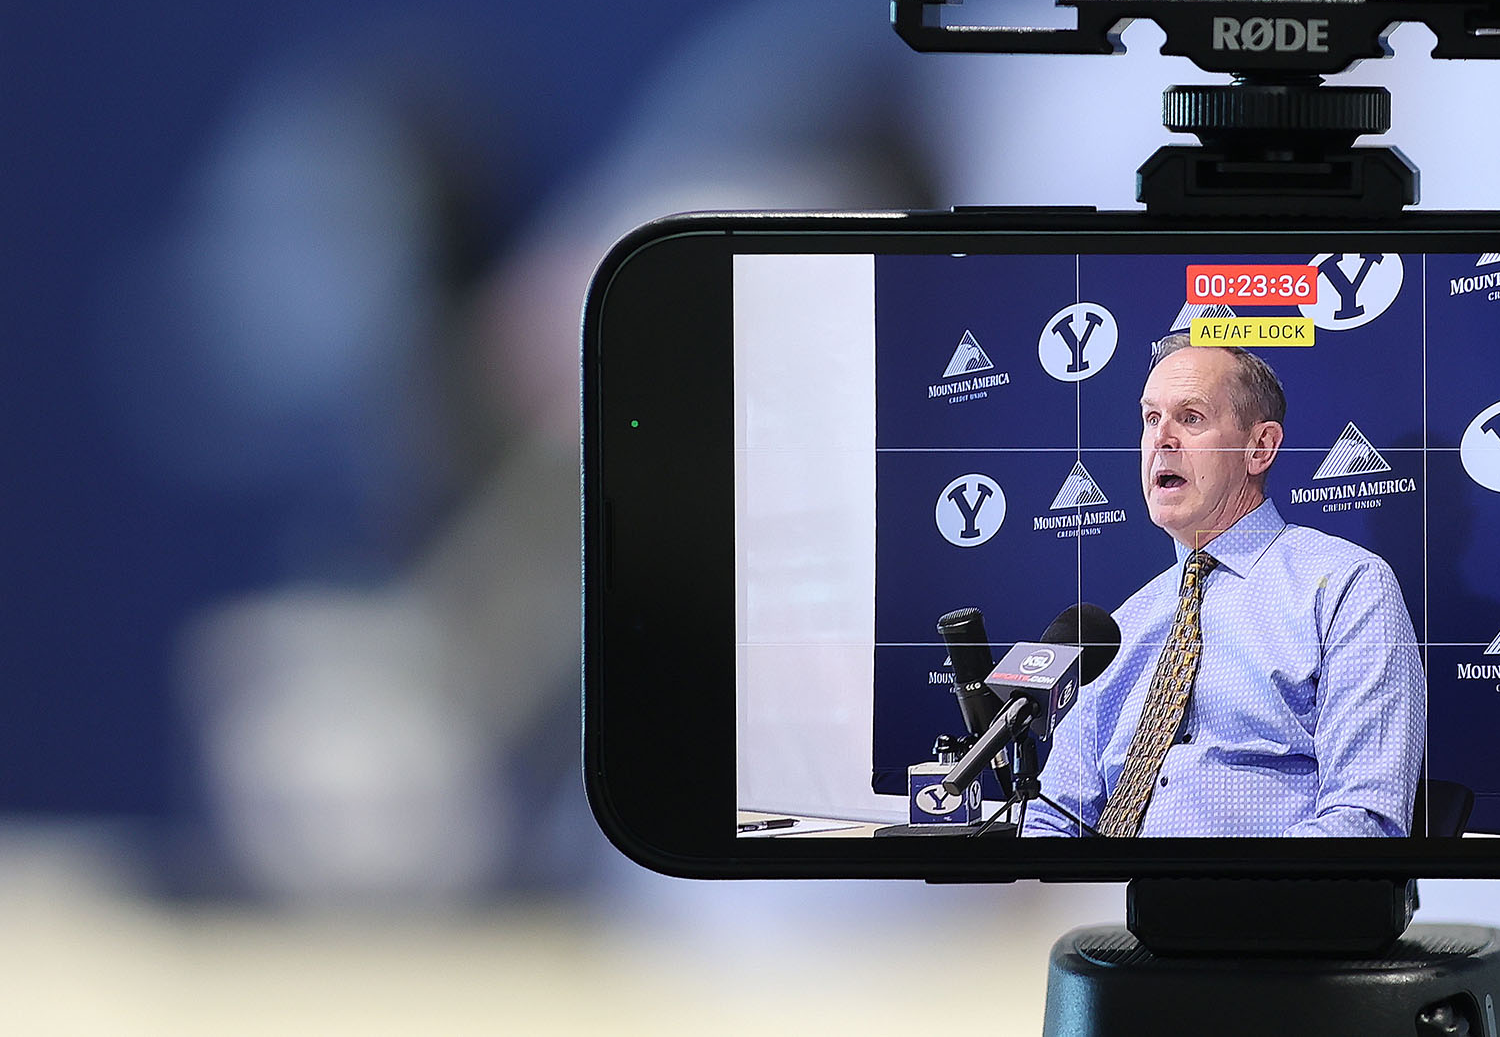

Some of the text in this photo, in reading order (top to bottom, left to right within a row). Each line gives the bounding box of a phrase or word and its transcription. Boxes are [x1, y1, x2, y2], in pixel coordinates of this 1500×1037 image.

[1213, 16, 1329, 52] RØDE
[1195, 275, 1310, 297] 00:23:36
[1051, 312, 1104, 373] Y
[1200, 324, 1305, 339] AE/AF LOCK
[972, 372, 1010, 391] AMERICA
[1291, 478, 1416, 504] MOUNTAIN AMERICA
[947, 482, 993, 539] Y
[1322, 499, 1382, 513] CREDIT UNION
[1033, 509, 1126, 530] MOUNTAIN AMERICA
